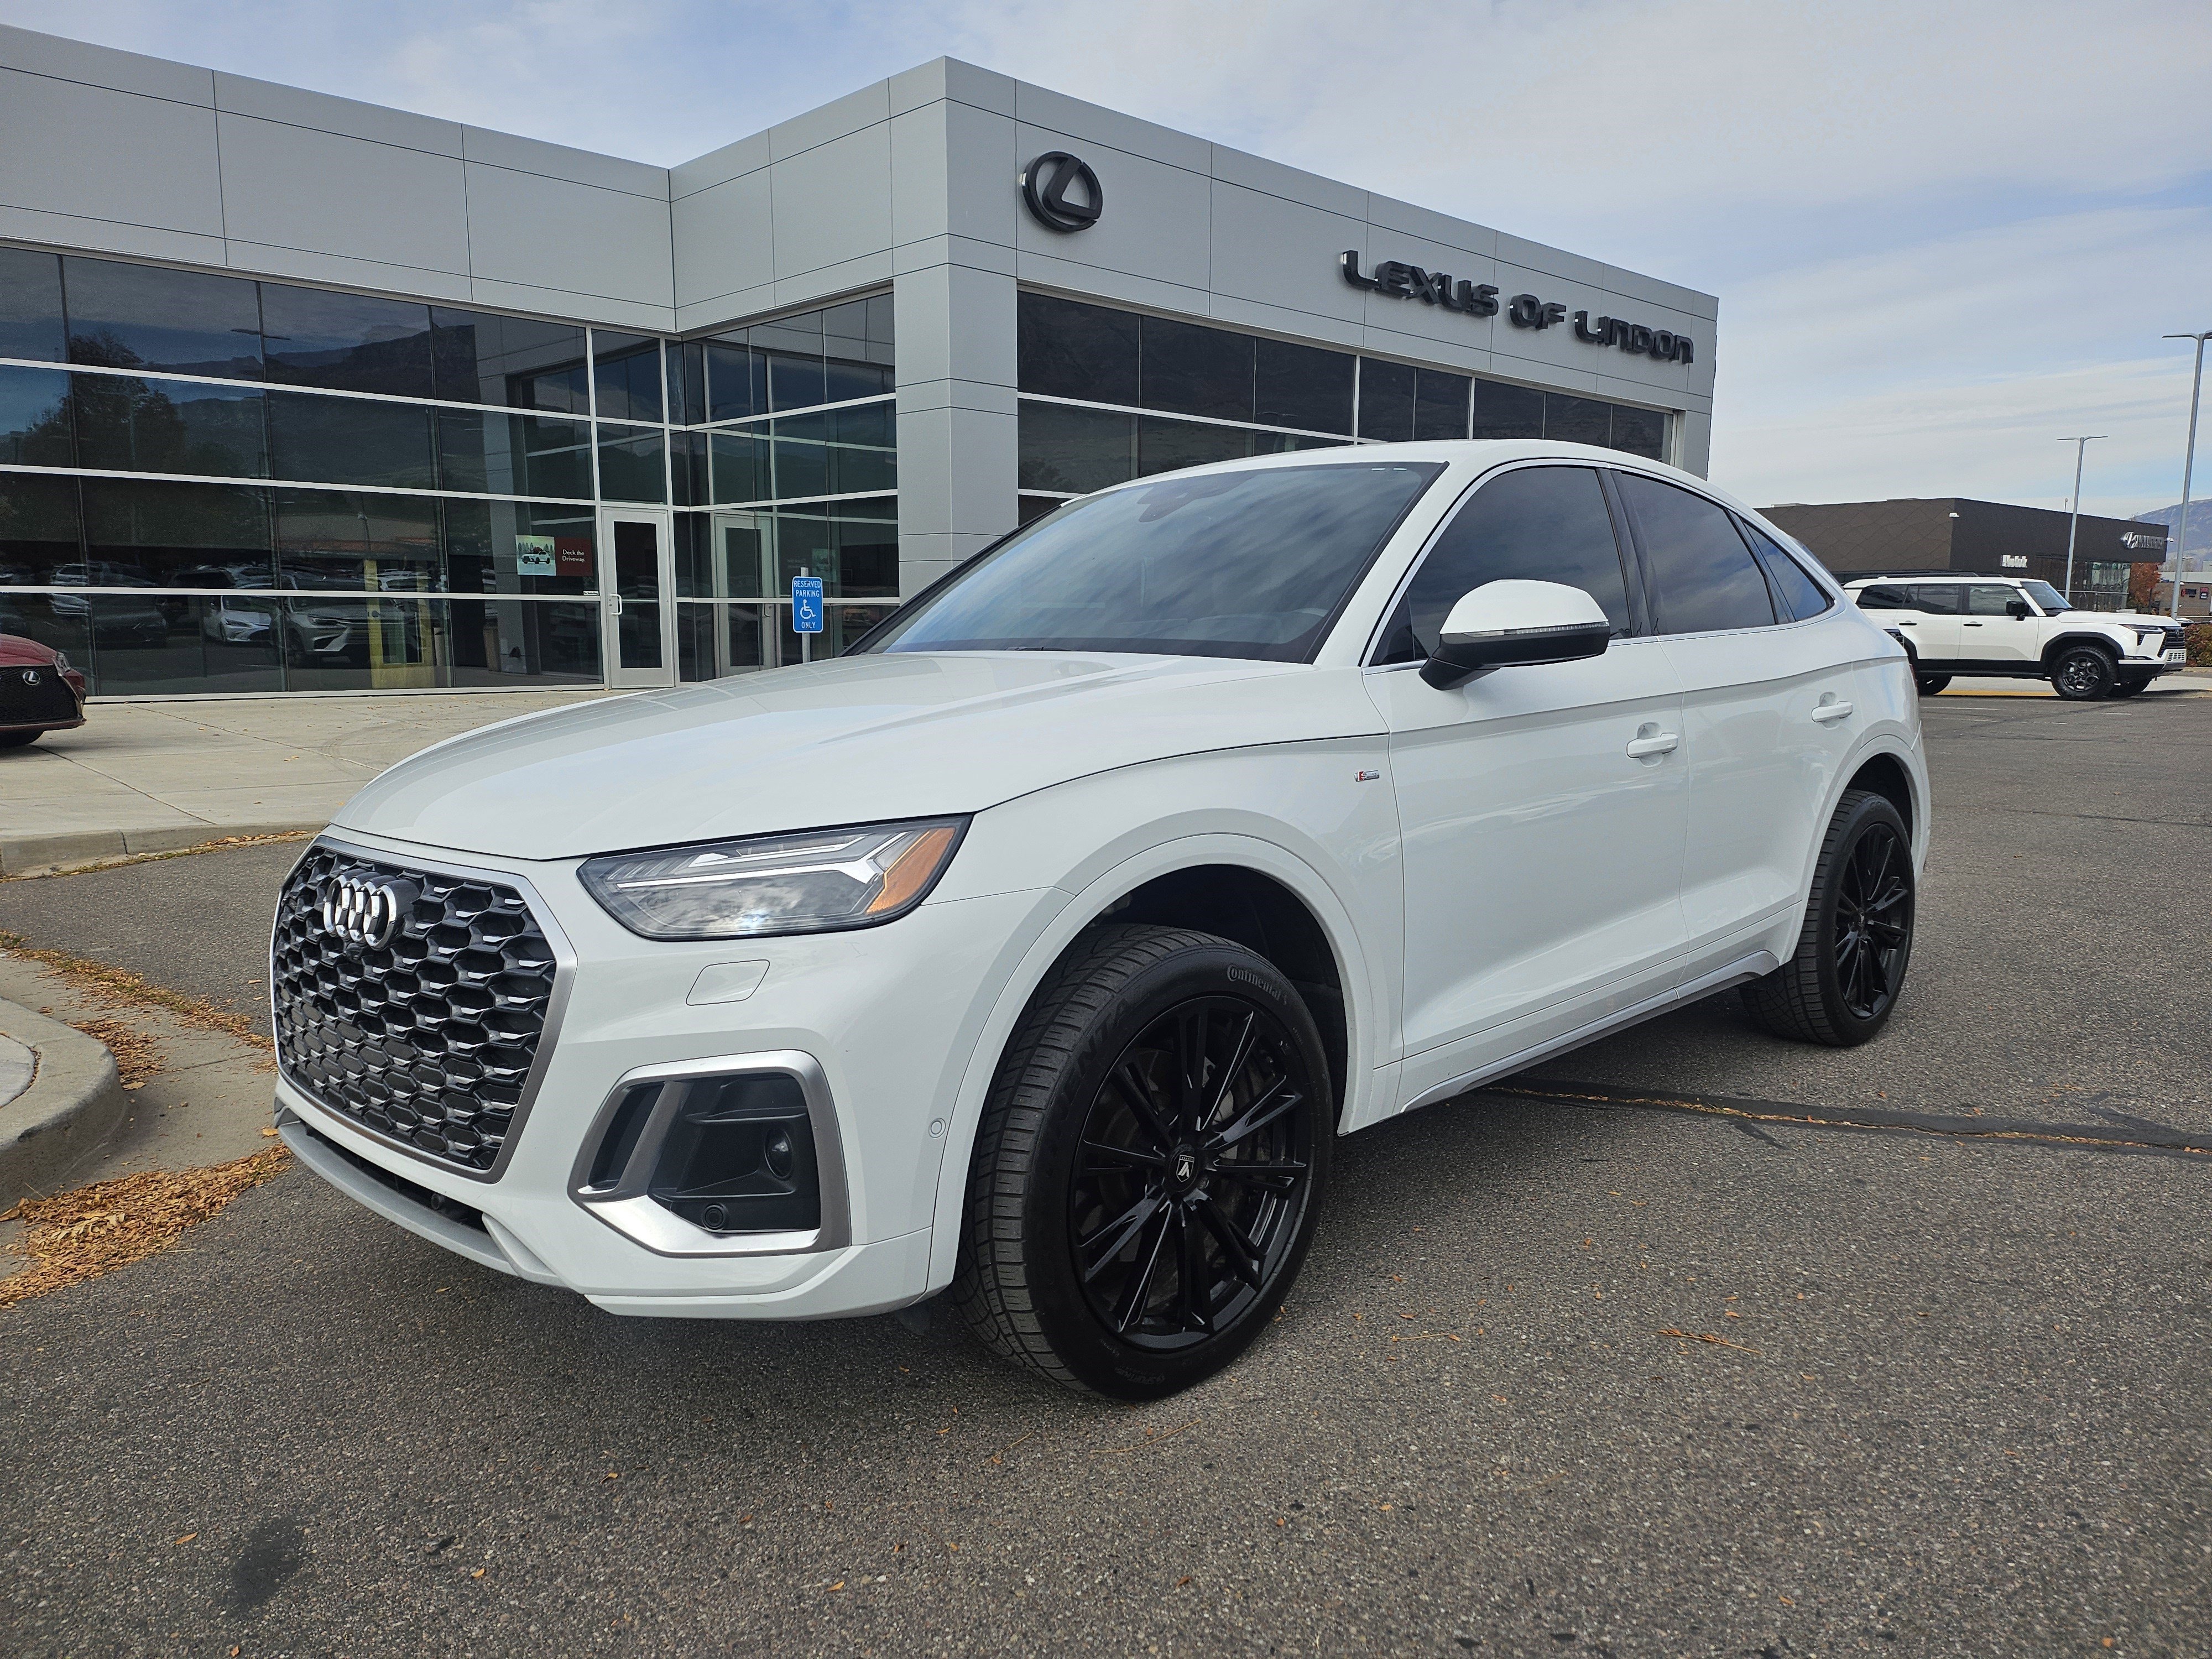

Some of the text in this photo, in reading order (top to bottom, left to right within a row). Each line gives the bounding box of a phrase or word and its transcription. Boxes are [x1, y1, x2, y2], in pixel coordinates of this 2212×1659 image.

[1342, 250, 1499, 316] LEXUS
[1509, 294, 1566, 330] OF
[794, 580, 821, 588] RESERVED
[795, 589, 820, 598] PARKING
[1227, 963, 1282, 1001] Continental
